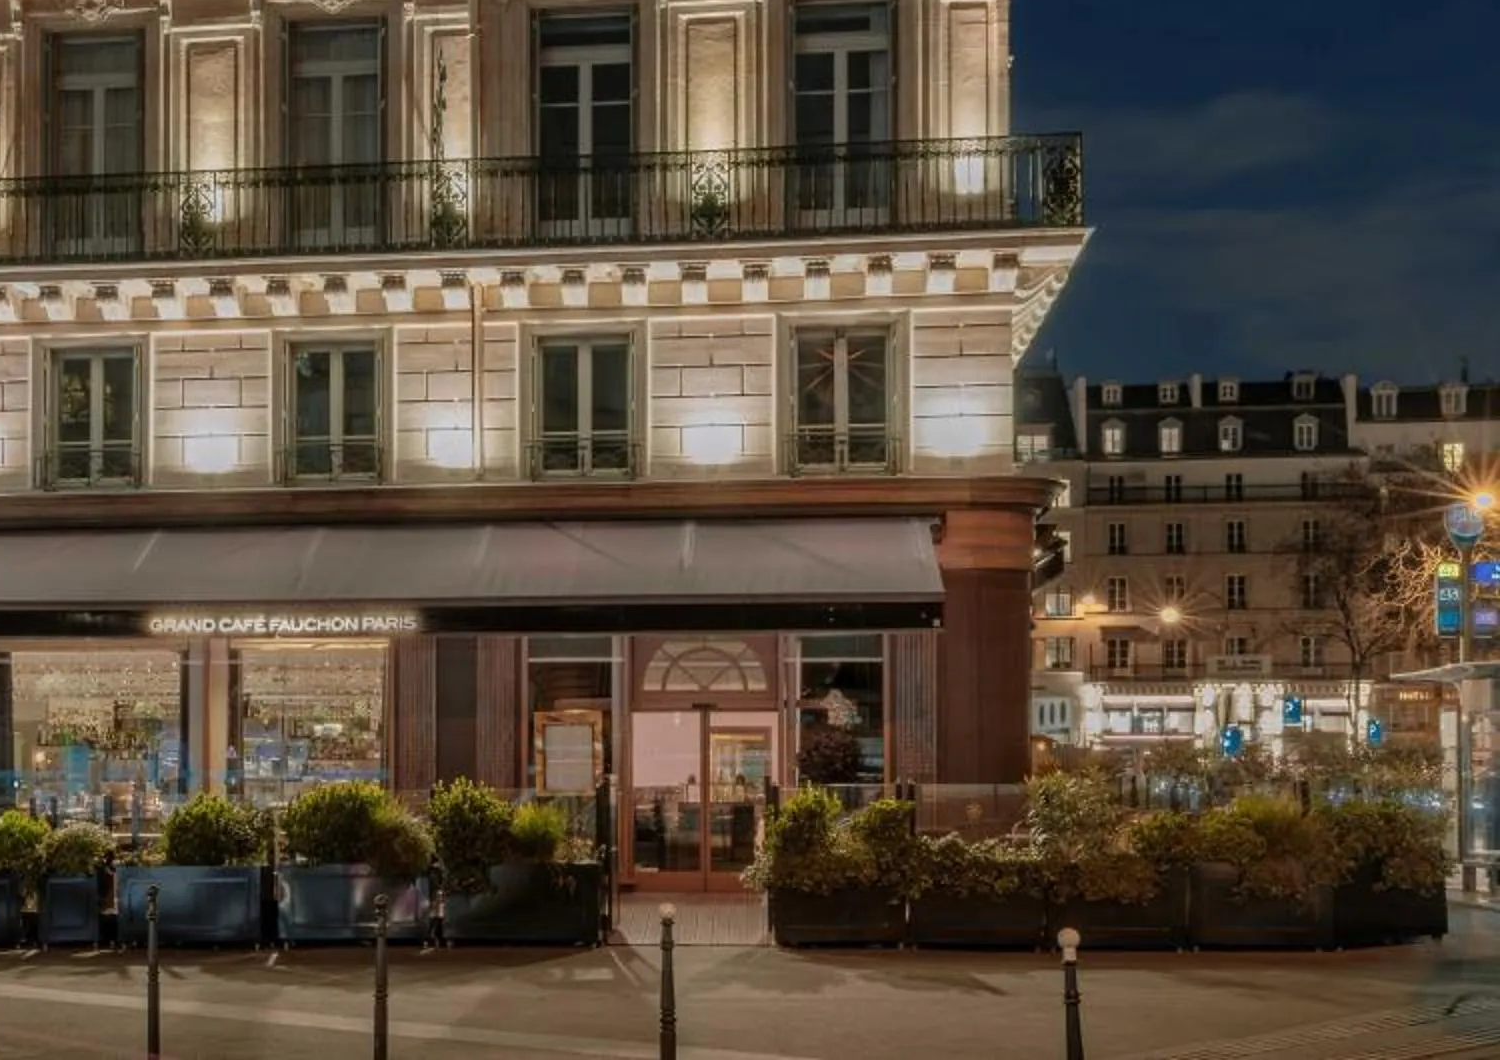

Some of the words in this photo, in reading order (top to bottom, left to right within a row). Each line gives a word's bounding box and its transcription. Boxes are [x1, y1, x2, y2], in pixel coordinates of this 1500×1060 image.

[149, 618, 216, 633] GRAND
[219, 614, 267, 633] CAFÉ
[269, 616, 359, 632] FAUCHON
[361, 616, 418, 630] PARIS
